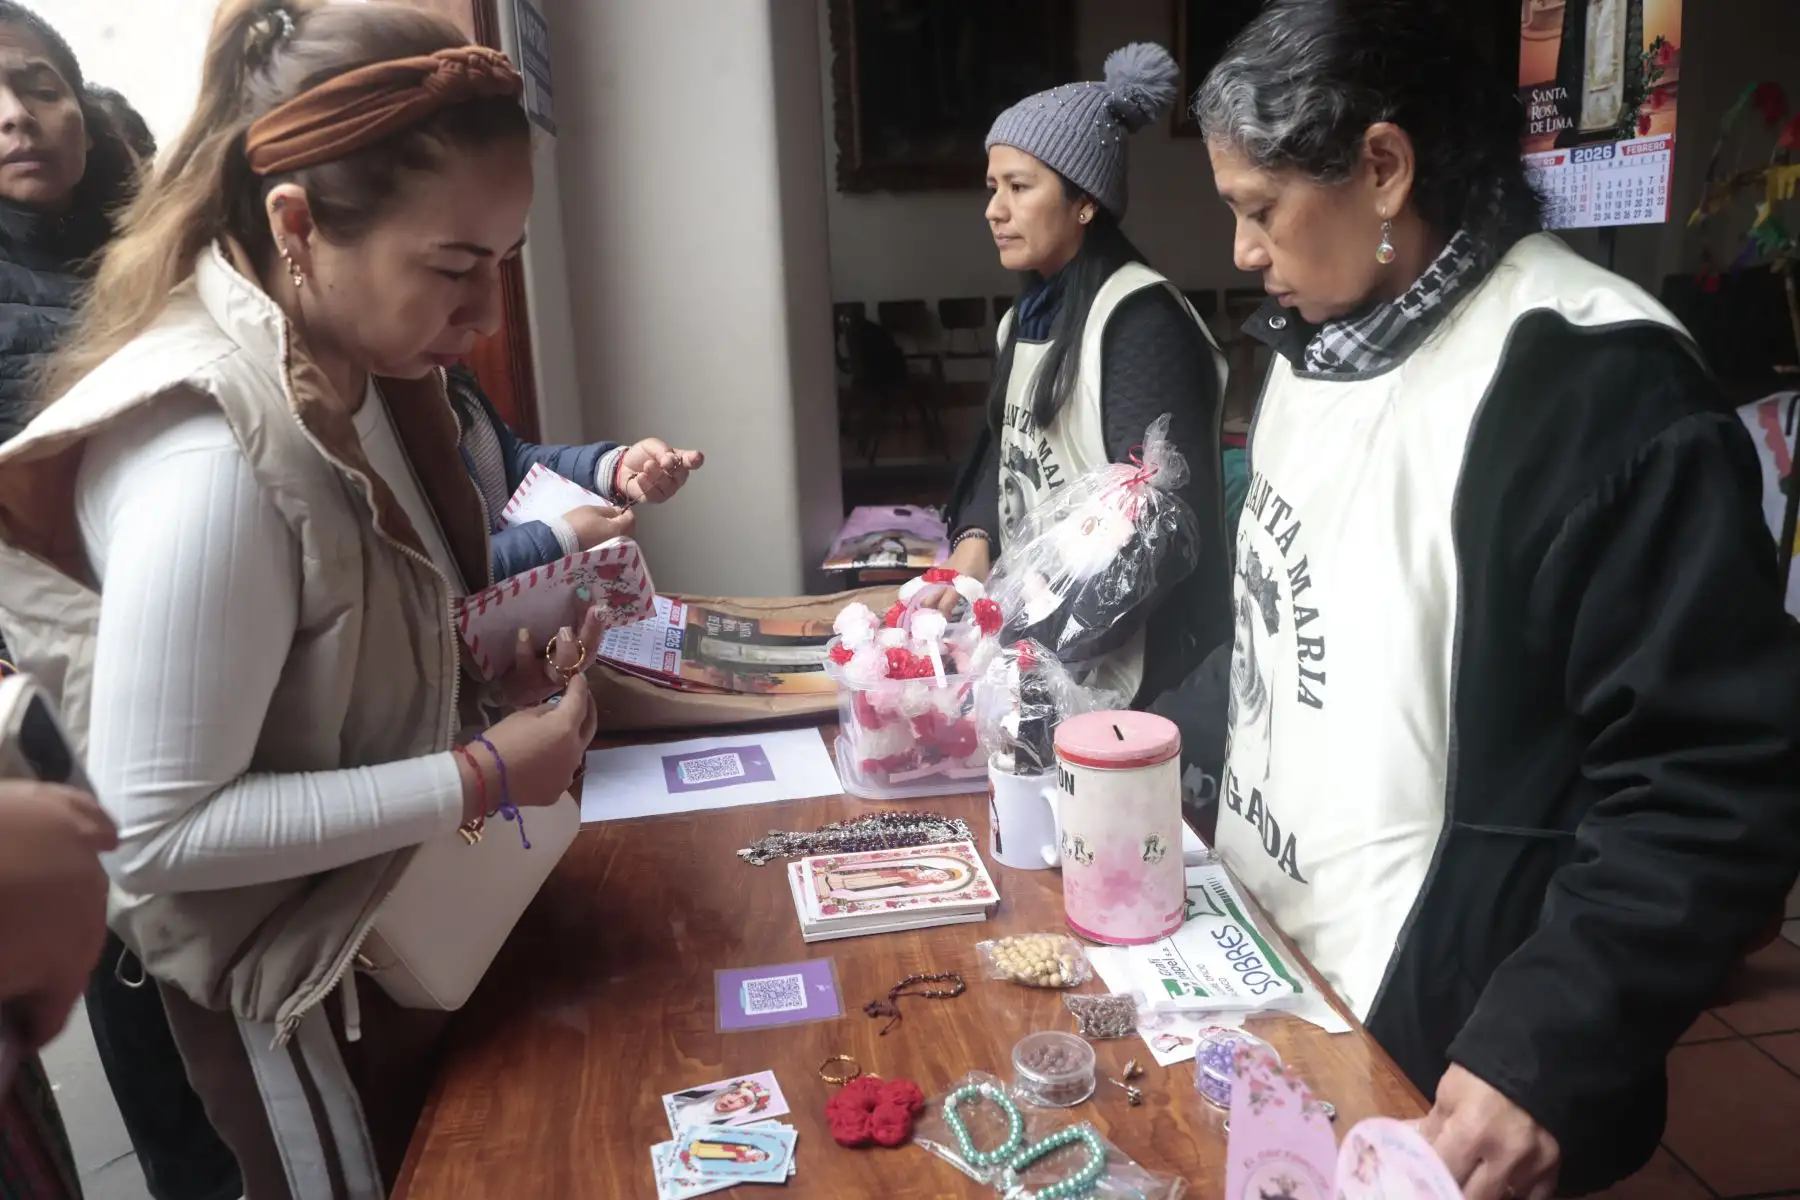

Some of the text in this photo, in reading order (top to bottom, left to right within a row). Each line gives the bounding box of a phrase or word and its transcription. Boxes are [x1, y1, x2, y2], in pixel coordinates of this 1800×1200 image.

[1531, 87, 1568, 105] SANTA
[1531, 104, 1559, 121] ROSA
[1530, 116, 1574, 134] DE LIMA
[1574, 146, 1612, 162] 2026
[1626, 141, 1666, 155] FEBRERO
[666, 628, 682, 649] 2026
[1287, 553, 1326, 710] MARIA
[1211, 924, 1282, 995] SOBRES
